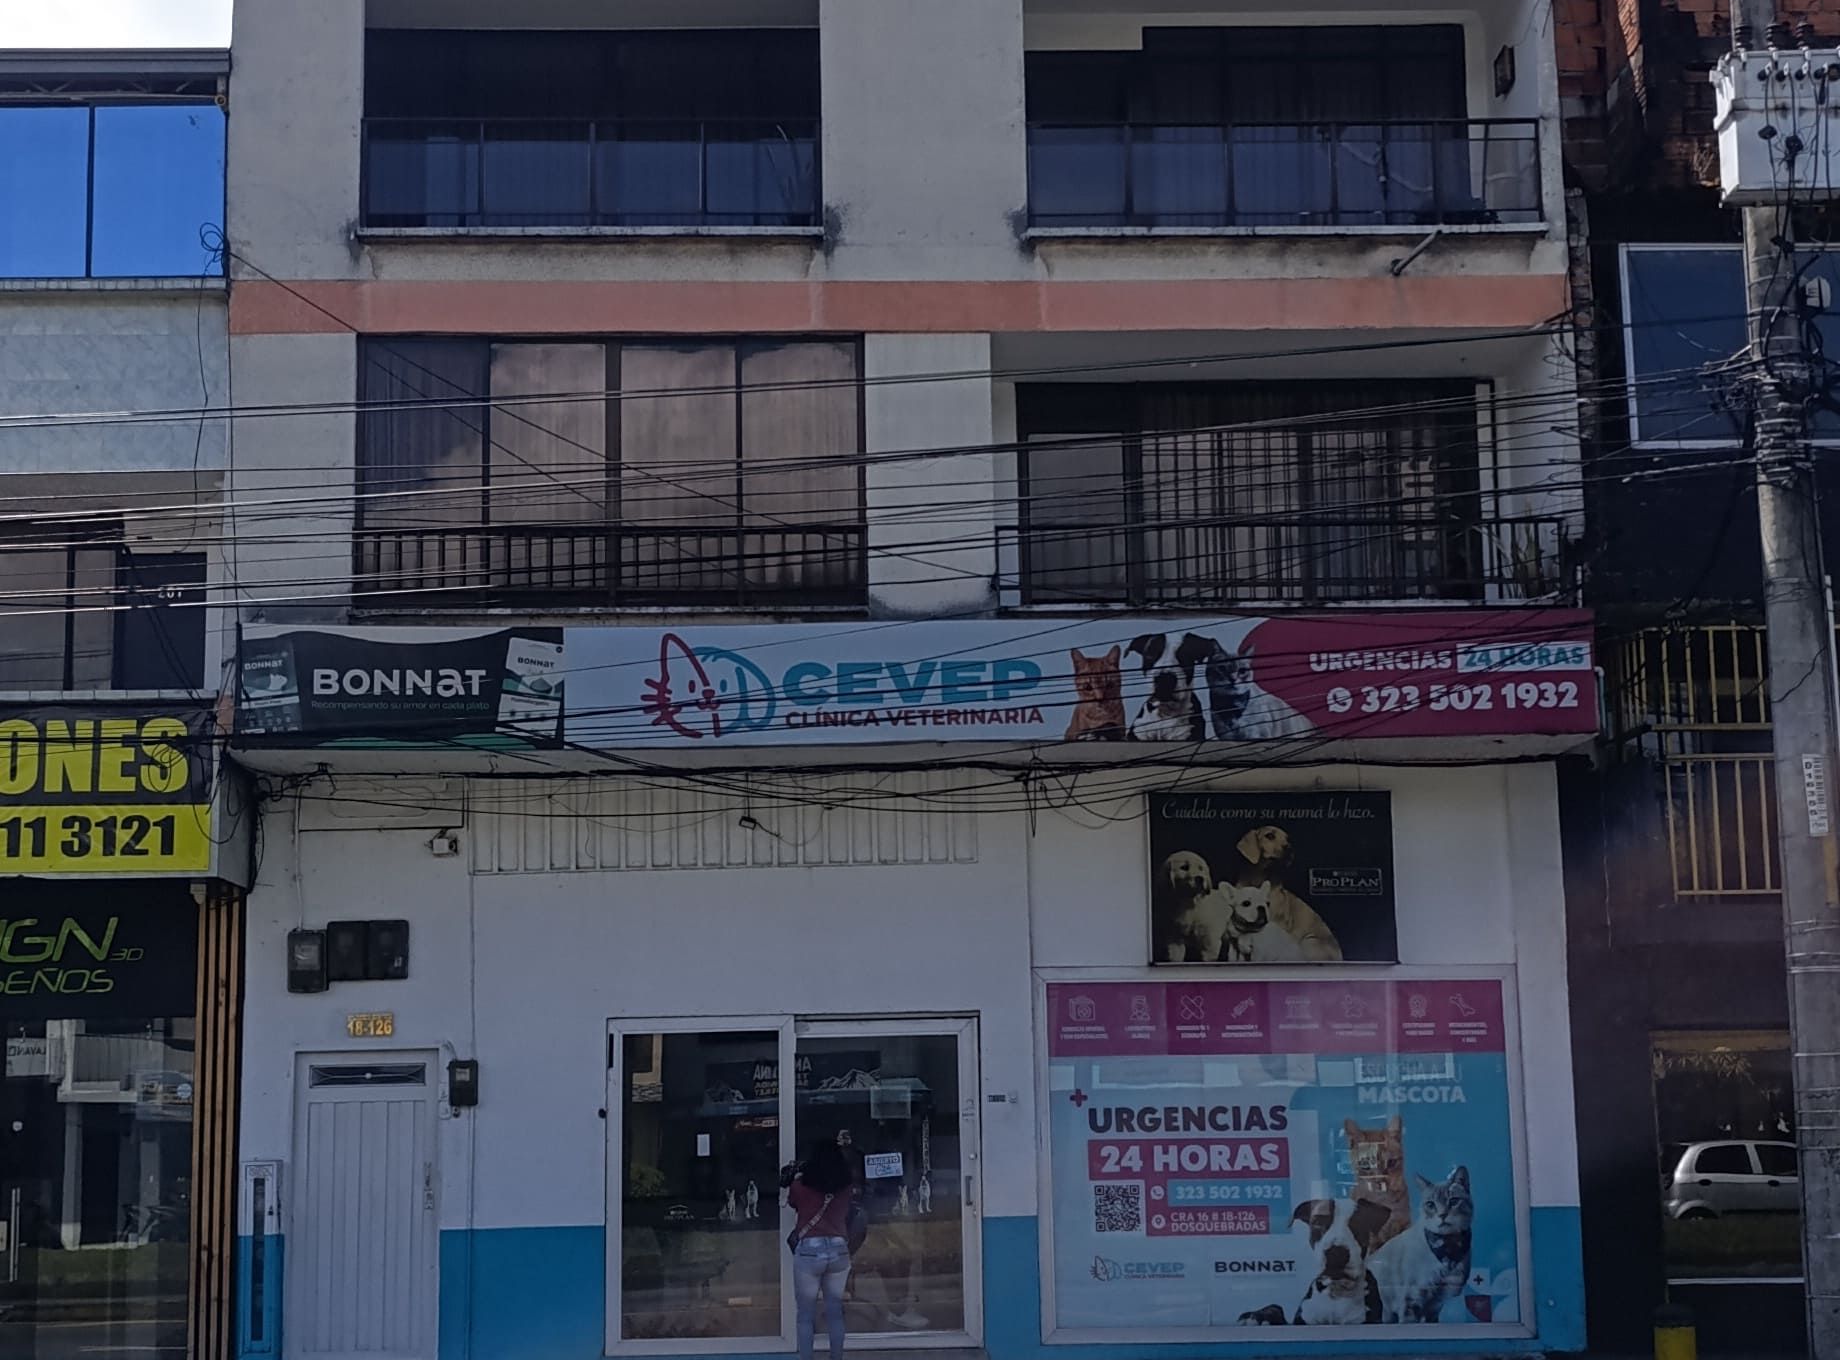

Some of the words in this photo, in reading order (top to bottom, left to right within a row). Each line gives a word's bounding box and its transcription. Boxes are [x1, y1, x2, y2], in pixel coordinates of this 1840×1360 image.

[1310, 650, 1451, 671] URGENCIAS
[1465, 649, 1490, 669] 24
[1498, 646, 1584, 668] HORAS
[782, 660, 1042, 705] CEVEP
[311, 700, 389, 711] Recompensando
[1361, 685, 1420, 711] 323
[1430, 684, 1493, 710] 502
[1501, 681, 1579, 709] 1932
[784, 706, 880, 728] CLÍNICA
[887, 707, 1045, 726] VETERINARIA
[1220, 808, 1257, 819] como
[1260, 808, 1275, 819] su
[1327, 797, 1340, 818] lo
[61, 814, 175, 858] 3121
[110, 948, 144, 961] 3D
[0, 967, 114, 995] EÑOS
[347, 1019, 393, 1037] 18-126
[1358, 1086, 1467, 1104] MASCOTA
[1088, 1105, 1288, 1133] URGENCIAS
[1100, 1144, 1144, 1173] 24
[1153, 1143, 1280, 1173] HORAS
[1175, 1185, 1206, 1200] 323
[1208, 1185, 1241, 1199] 502
[1245, 1185, 1283, 1199] 1932
[1170, 1211, 1193, 1222] CRA
[1197, 1211, 1209, 1221] 16
[1211, 1211, 1219, 1221] #
[1222, 1210, 1256, 1221] 18-126
[1171, 1221, 1267, 1232] DOSQUEBRADAS
[1123, 1262, 1185, 1274] CEVEP
